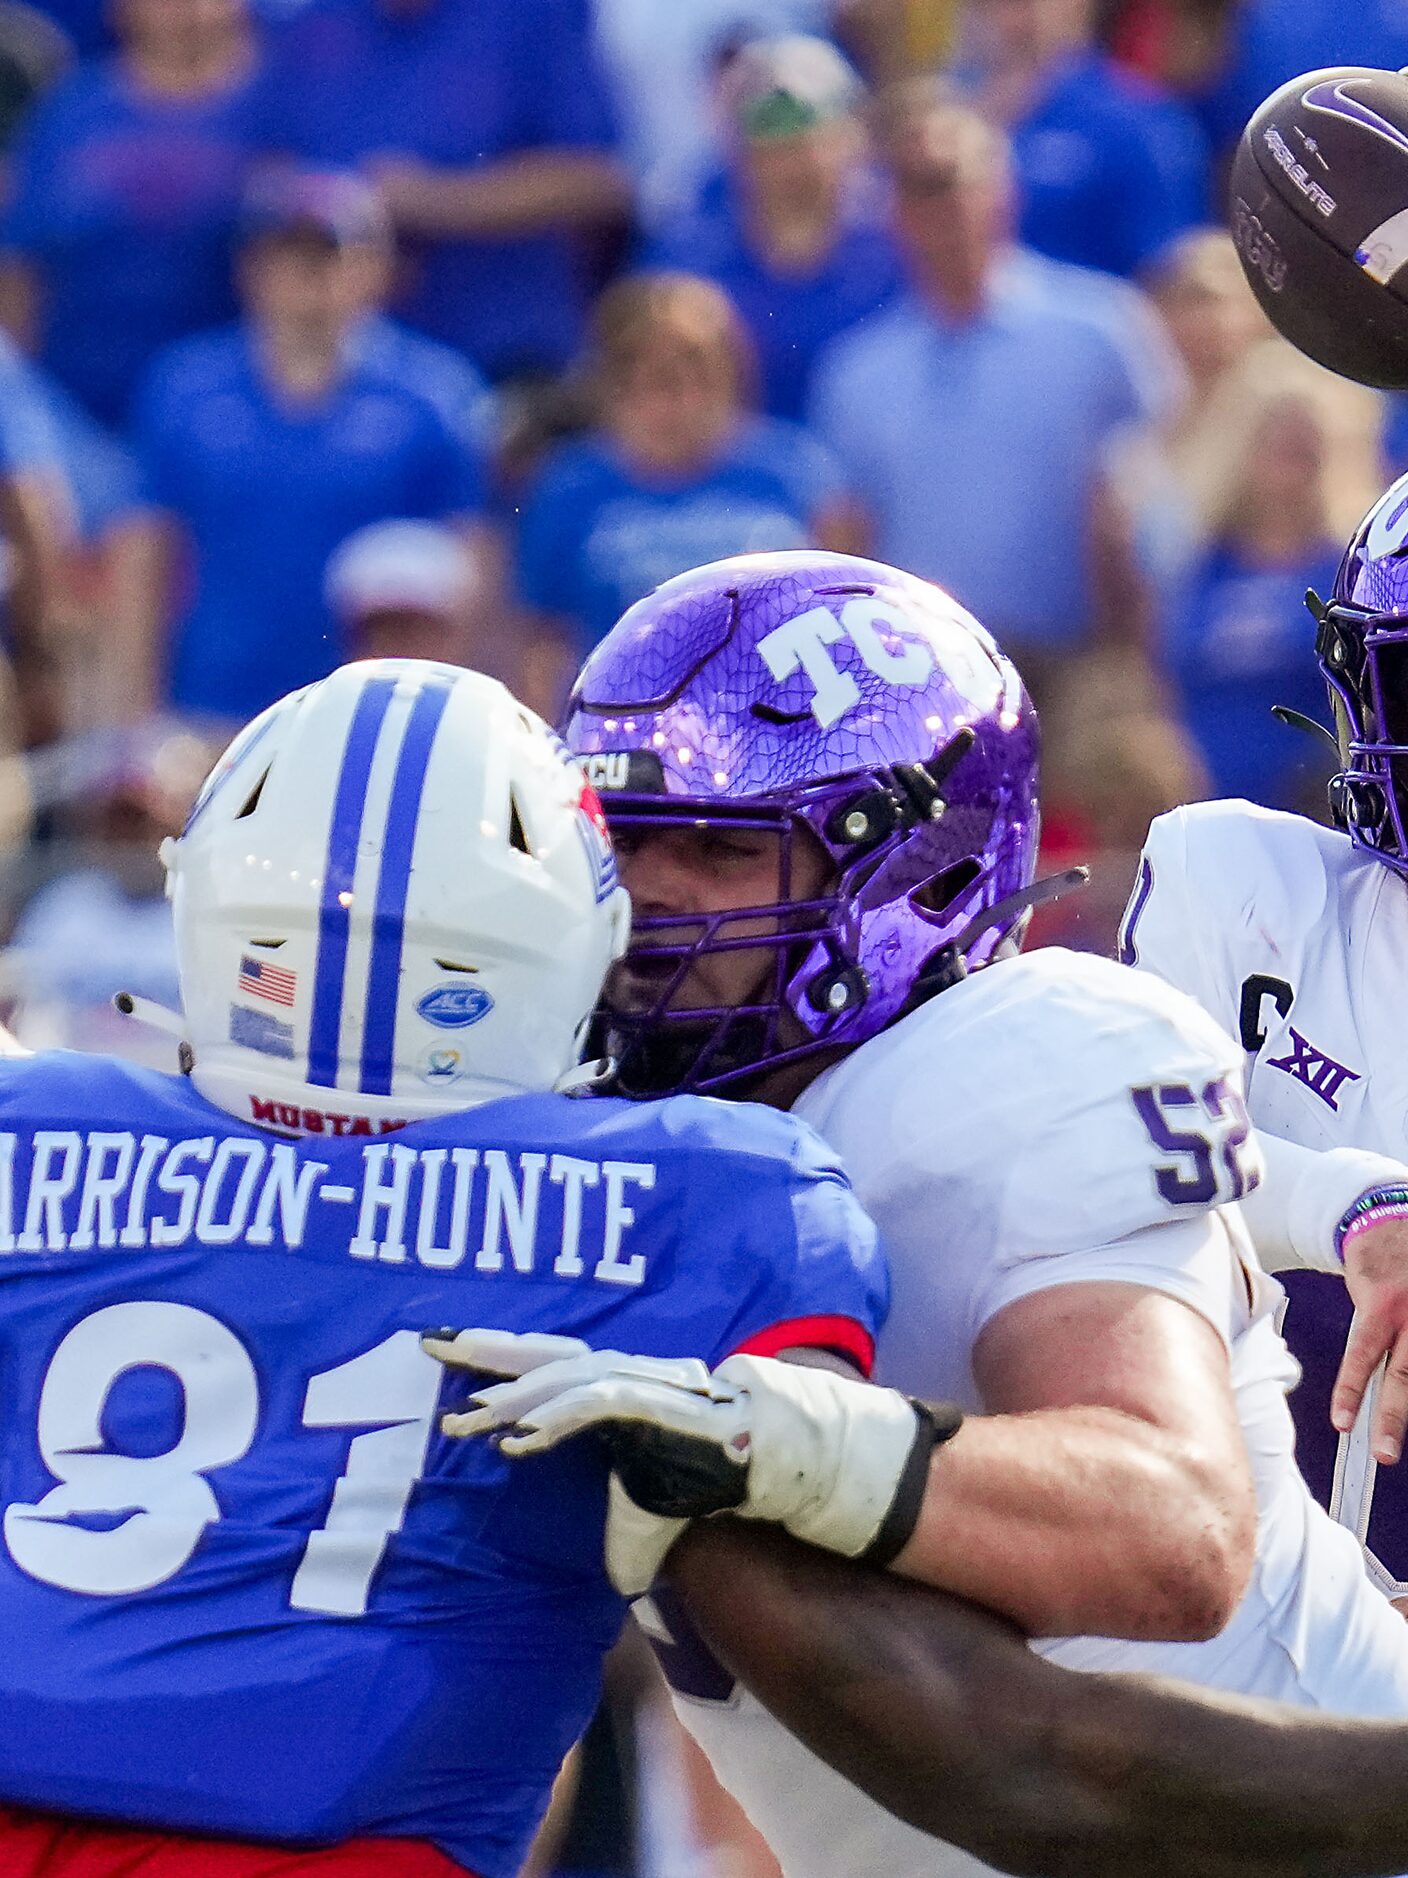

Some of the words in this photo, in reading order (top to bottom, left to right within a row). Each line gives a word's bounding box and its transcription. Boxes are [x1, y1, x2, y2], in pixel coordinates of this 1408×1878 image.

[1240, 974, 1294, 1052] C
[249, 1095, 424, 1137] MUSTAN
[1267, 1027, 1361, 1112] XII
[1129, 1076, 1261, 1206] 52
[0, 1130, 656, 1286] RRISON-HUNTE
[2, 1299, 446, 1617] 81
